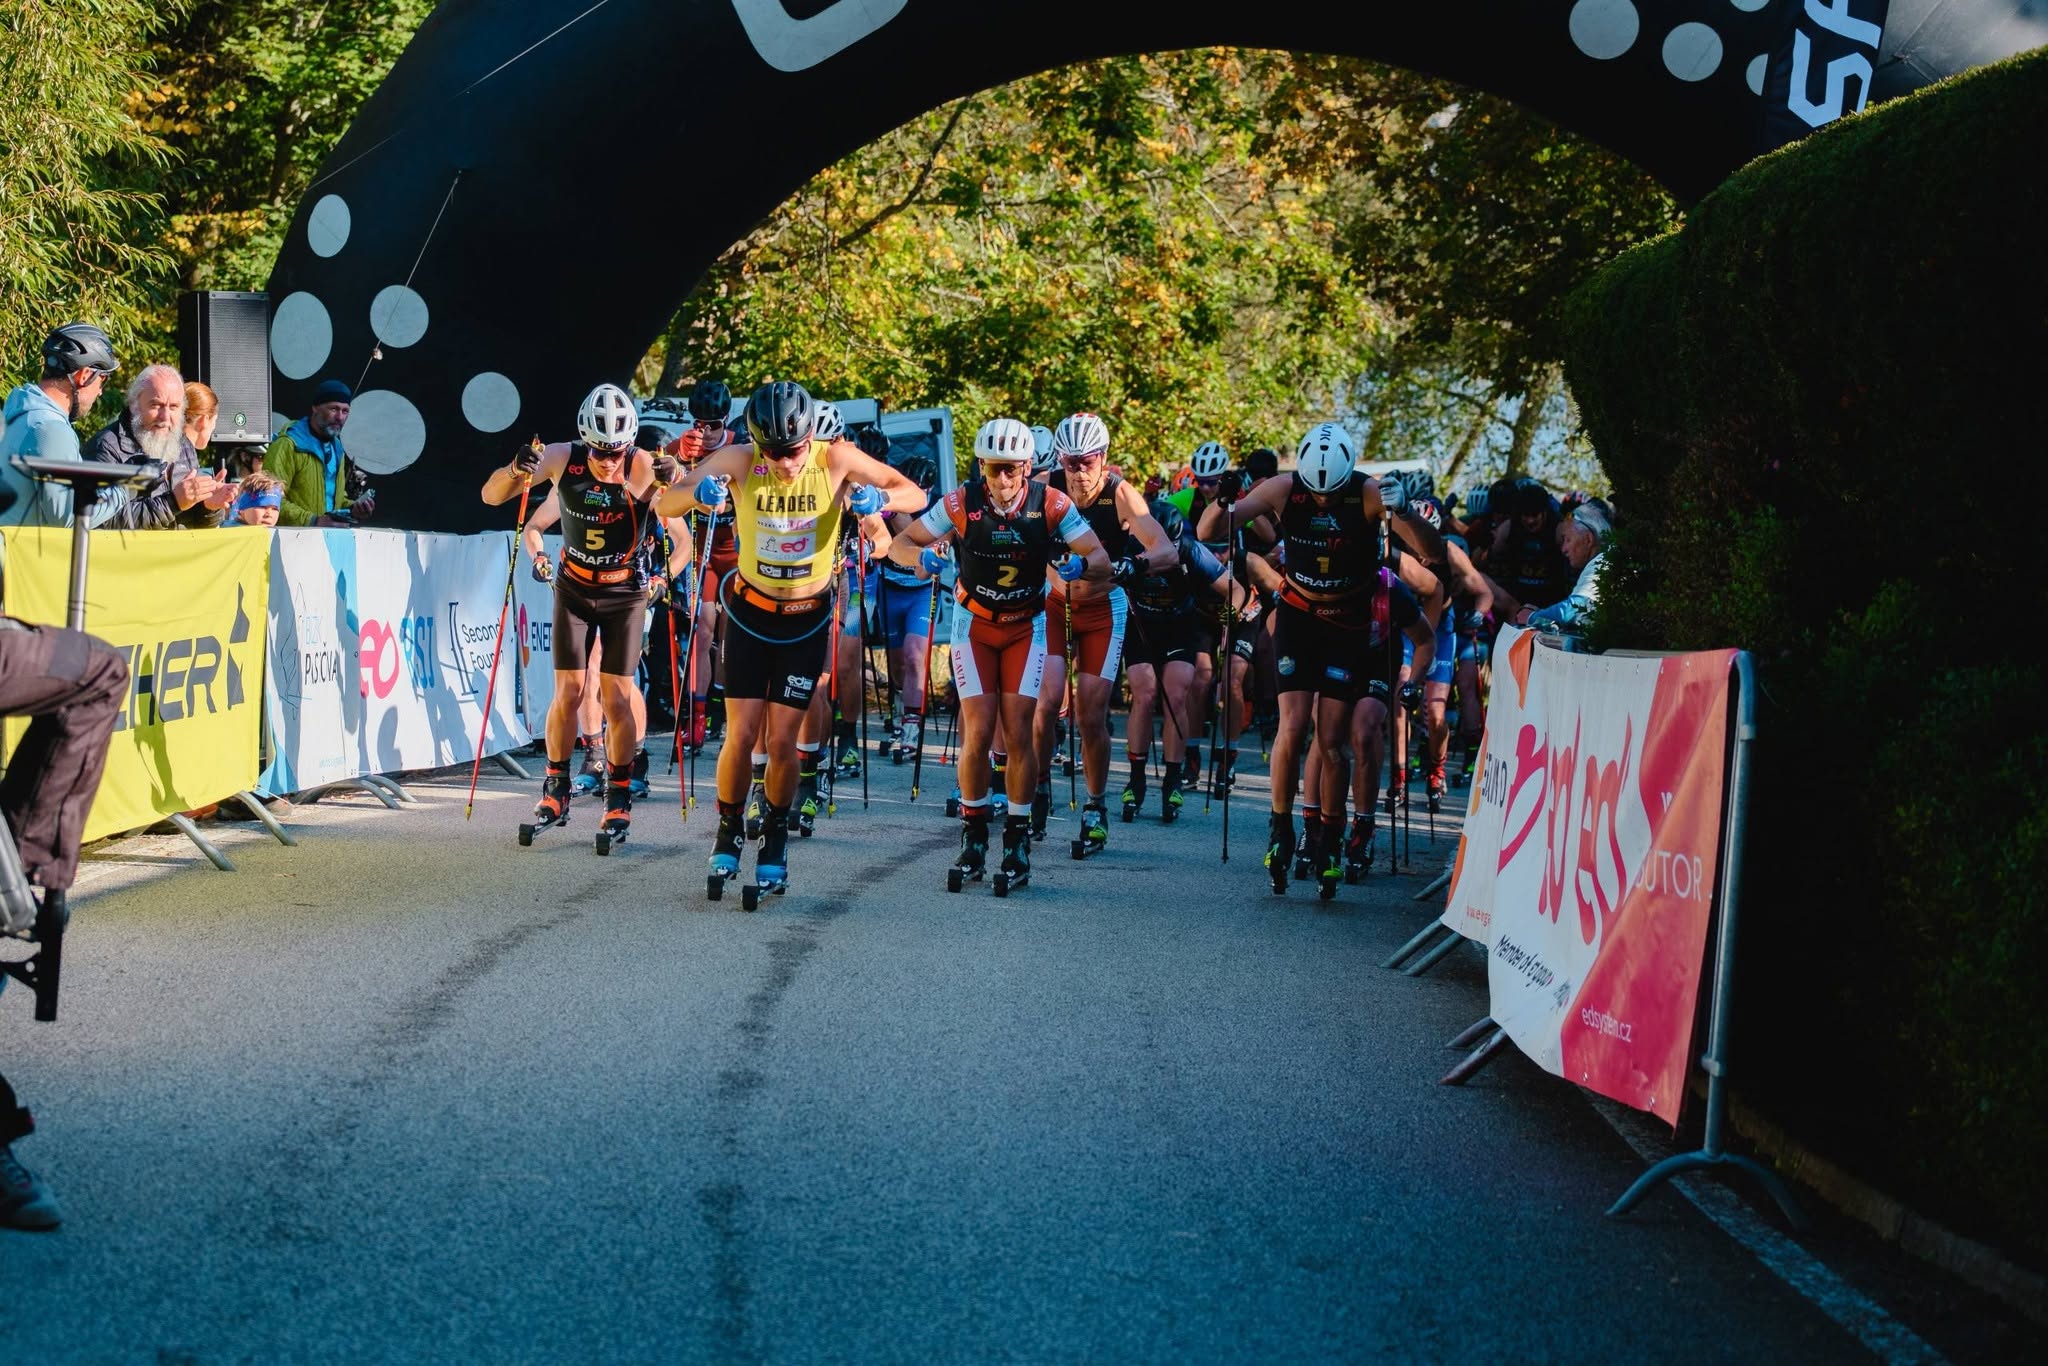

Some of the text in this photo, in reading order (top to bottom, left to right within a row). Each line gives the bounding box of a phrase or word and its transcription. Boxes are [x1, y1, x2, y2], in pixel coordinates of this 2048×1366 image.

[756, 494, 817, 513] LEADER
[585, 528, 606, 551] 5
[568, 546, 614, 565] CRAFT
[1316, 556, 1331, 574] 1
[997, 565, 1019, 588] 2
[1295, 572, 1342, 588] CRAFT
[975, 584, 1025, 601] CRAFT
[784, 603, 813, 612] COXA
[532, 622, 553, 652] ENE
[955, 650, 967, 688] SLAVIA
